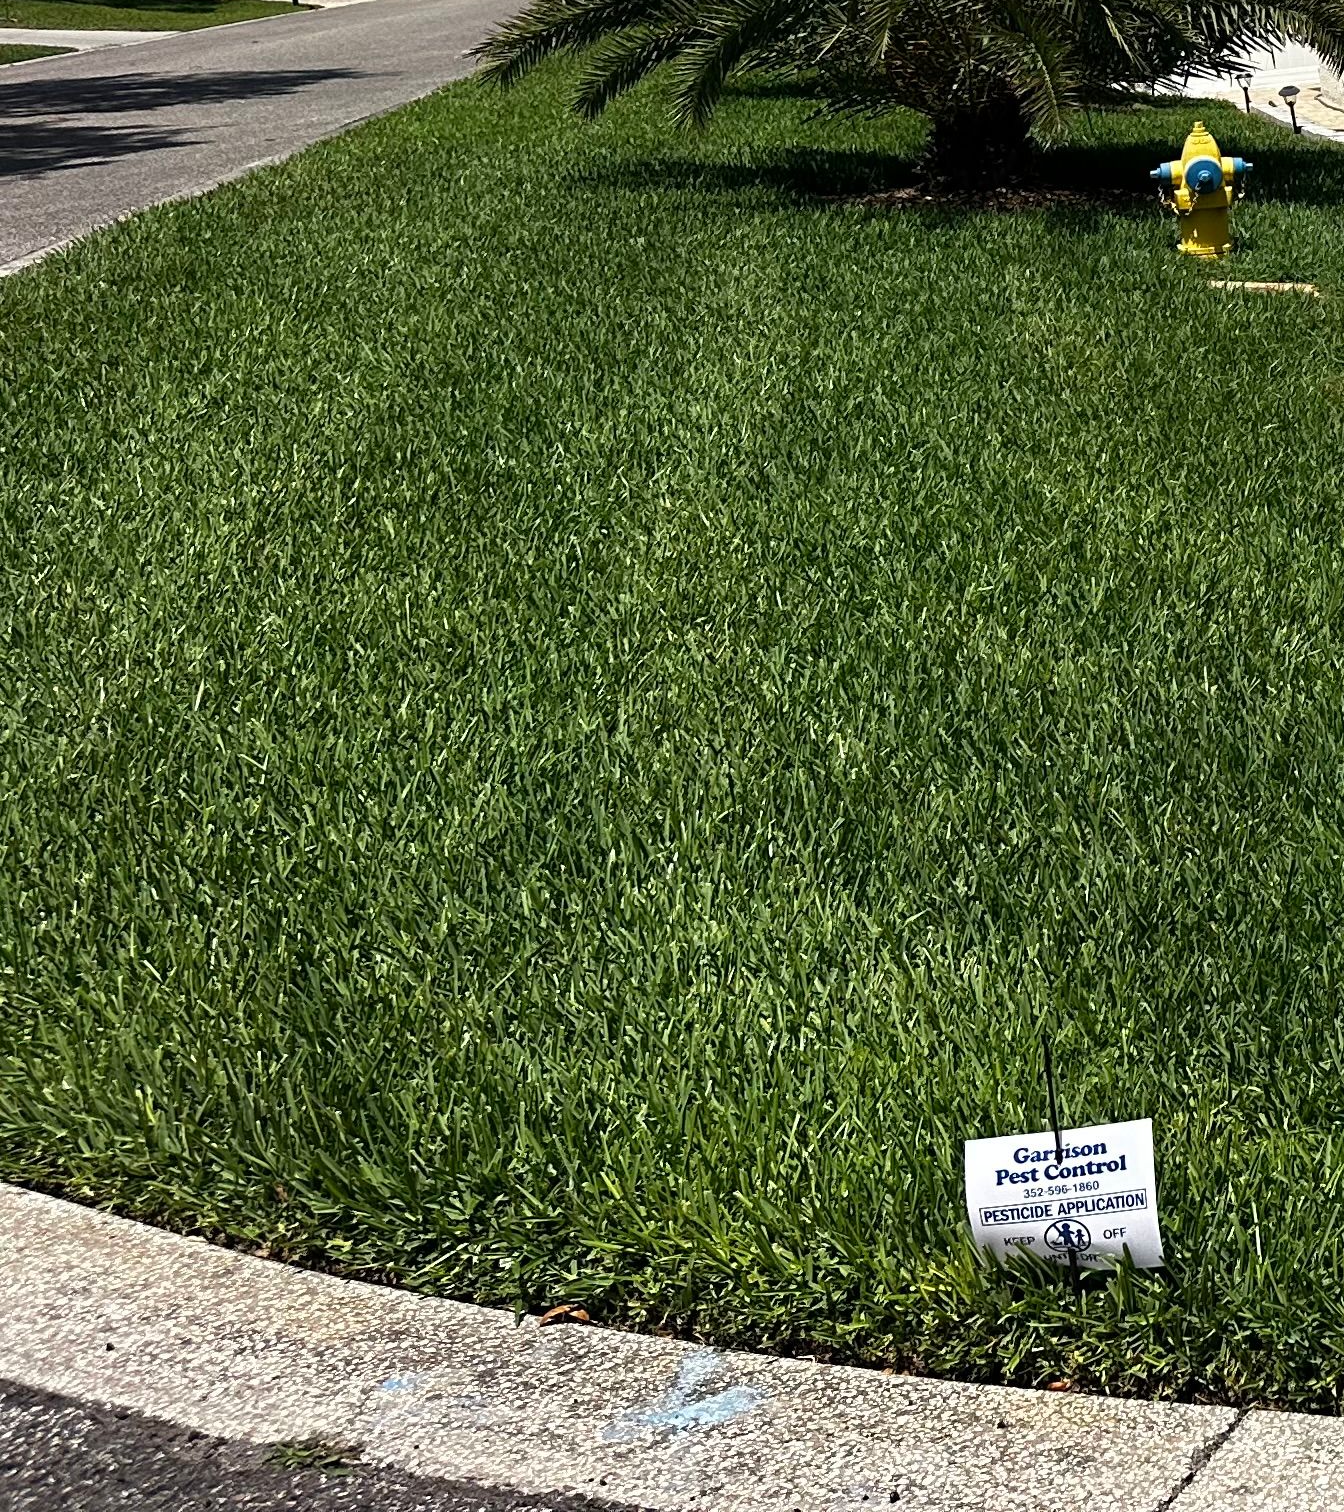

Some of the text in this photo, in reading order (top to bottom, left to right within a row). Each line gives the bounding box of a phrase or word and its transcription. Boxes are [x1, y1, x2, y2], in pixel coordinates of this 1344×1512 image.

[995, 1155, 1127, 1186] Pest Control
[1023, 1180, 1100, 1199] 352-596-1860
[983, 1193, 1145, 1223] PESTICIDE APPLICATION
[1103, 1227, 1127, 1240] OFF
